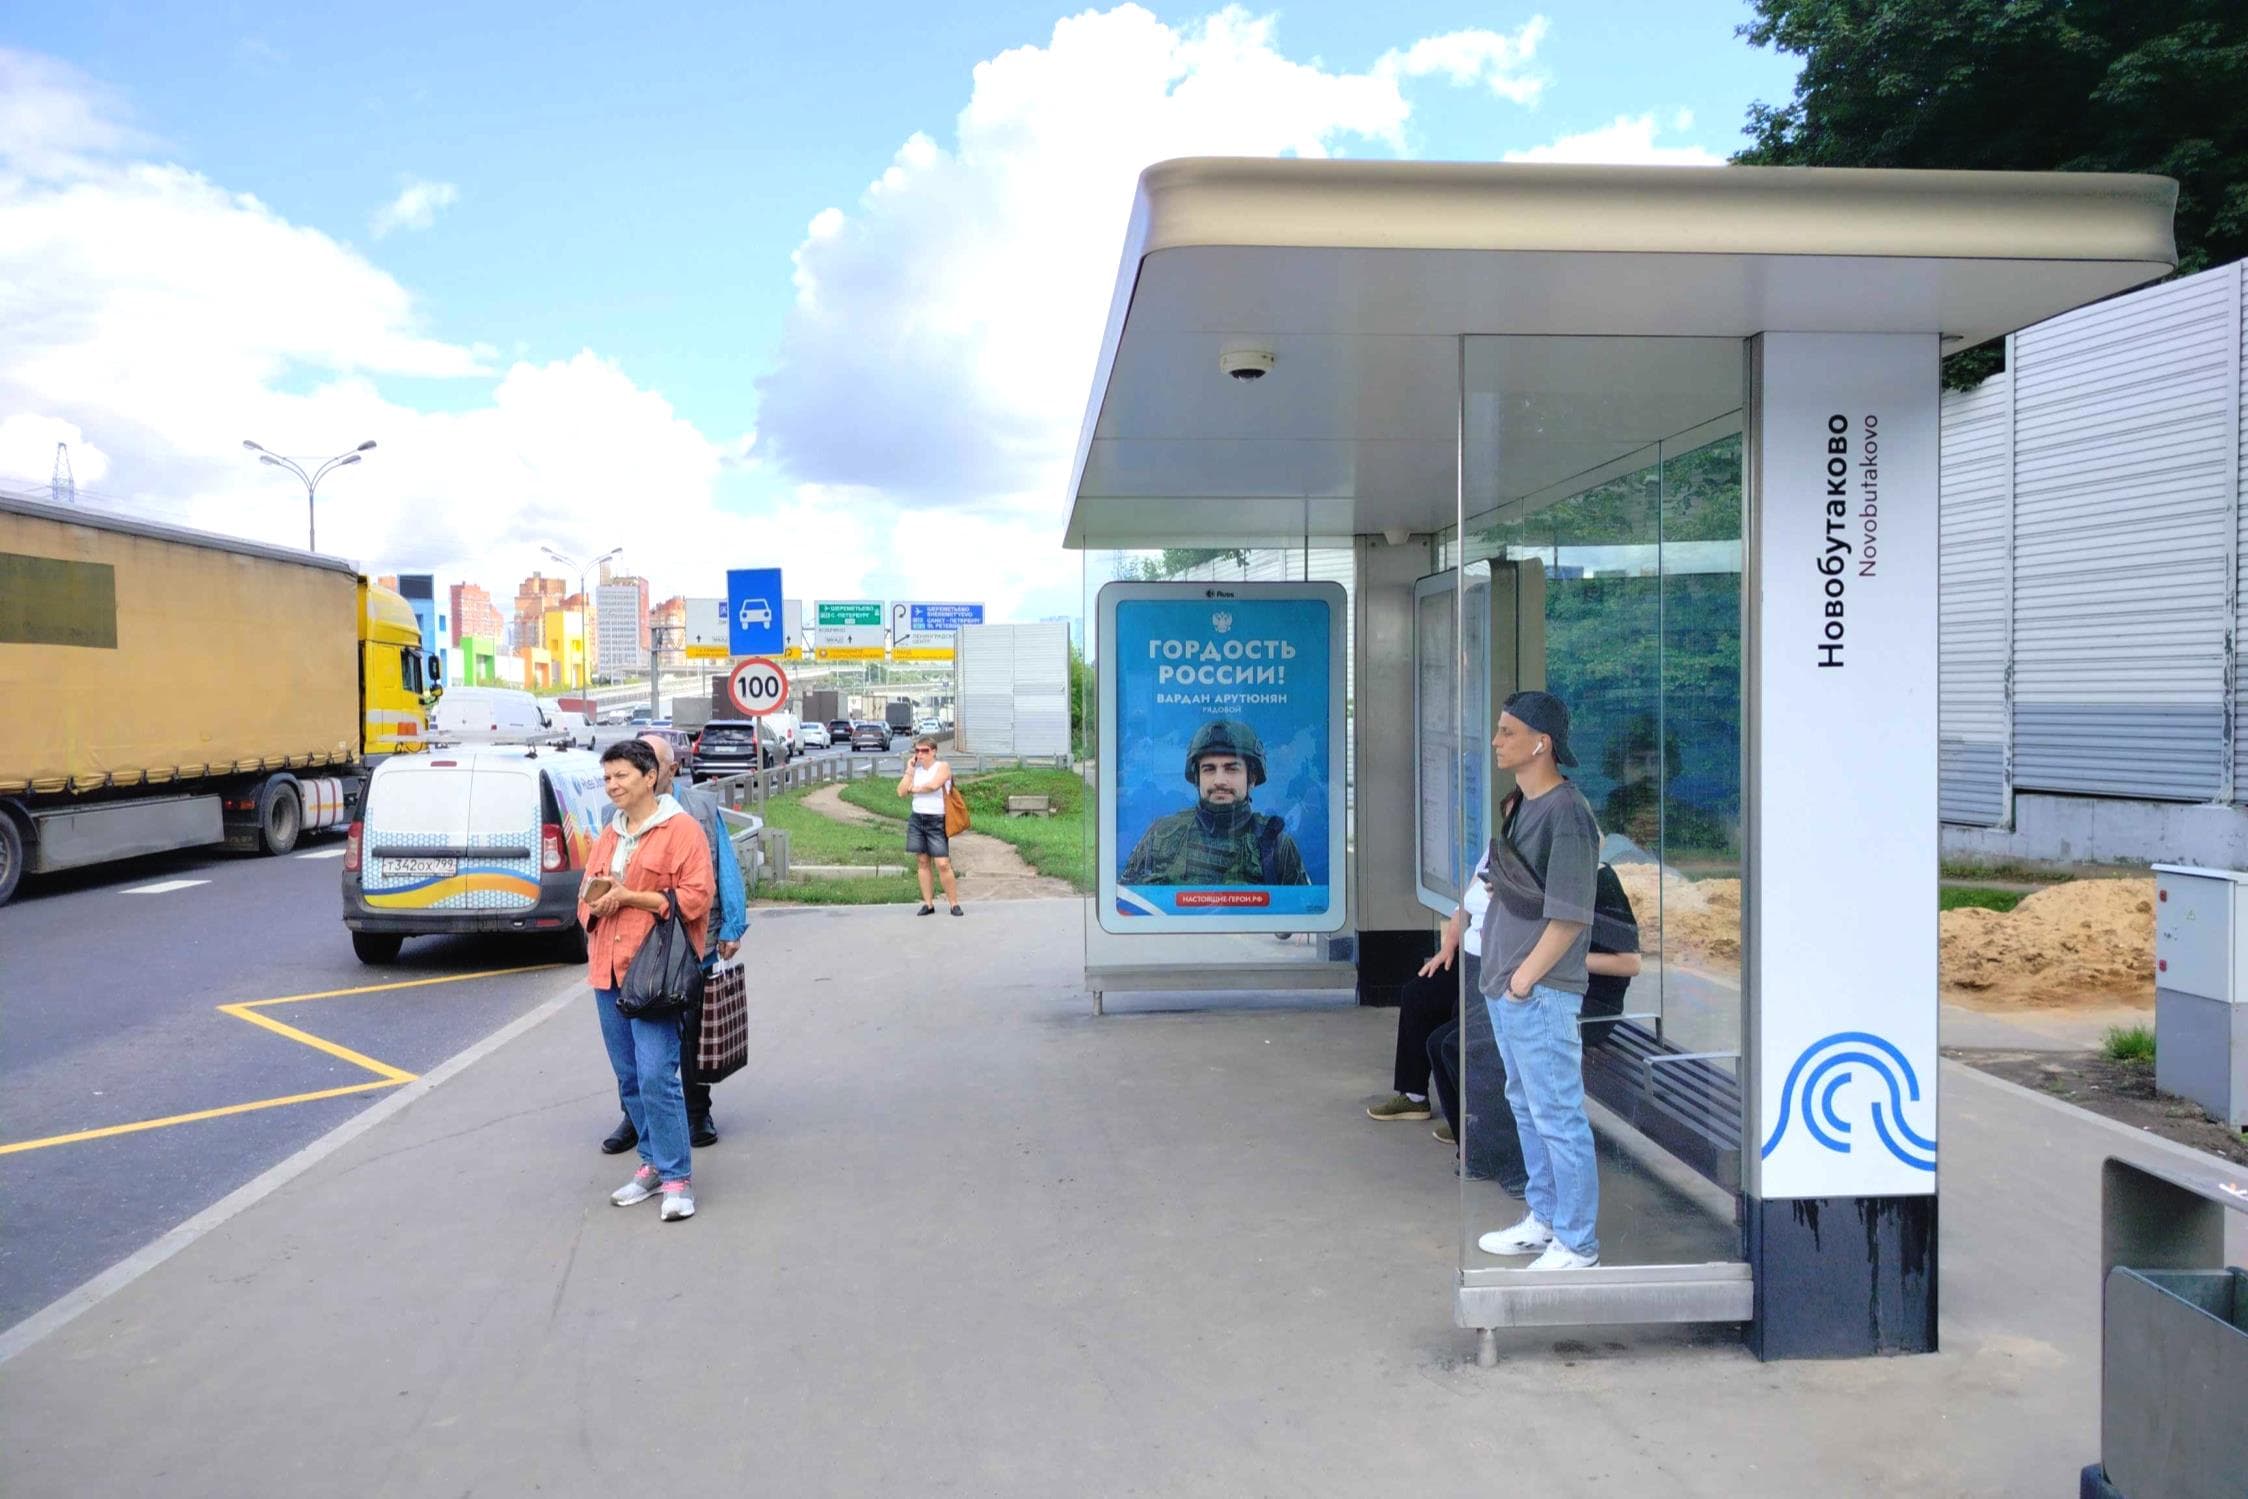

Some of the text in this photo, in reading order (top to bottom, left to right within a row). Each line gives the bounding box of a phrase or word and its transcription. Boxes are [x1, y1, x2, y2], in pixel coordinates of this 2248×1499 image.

[1858, 414, 1878, 577] Novobutakovo
[1816, 413, 1852, 668] Новобутаково
[1149, 639, 1296, 662] ГОРДОСТЬ
[1159, 665, 1286, 685] РОССИИ!
[737, 676, 779, 698] 100
[1156, 693, 1287, 704] ВАРДАН АРУТЮНЯН
[1202, 704, 1242, 713] РЯДОВОЙ
